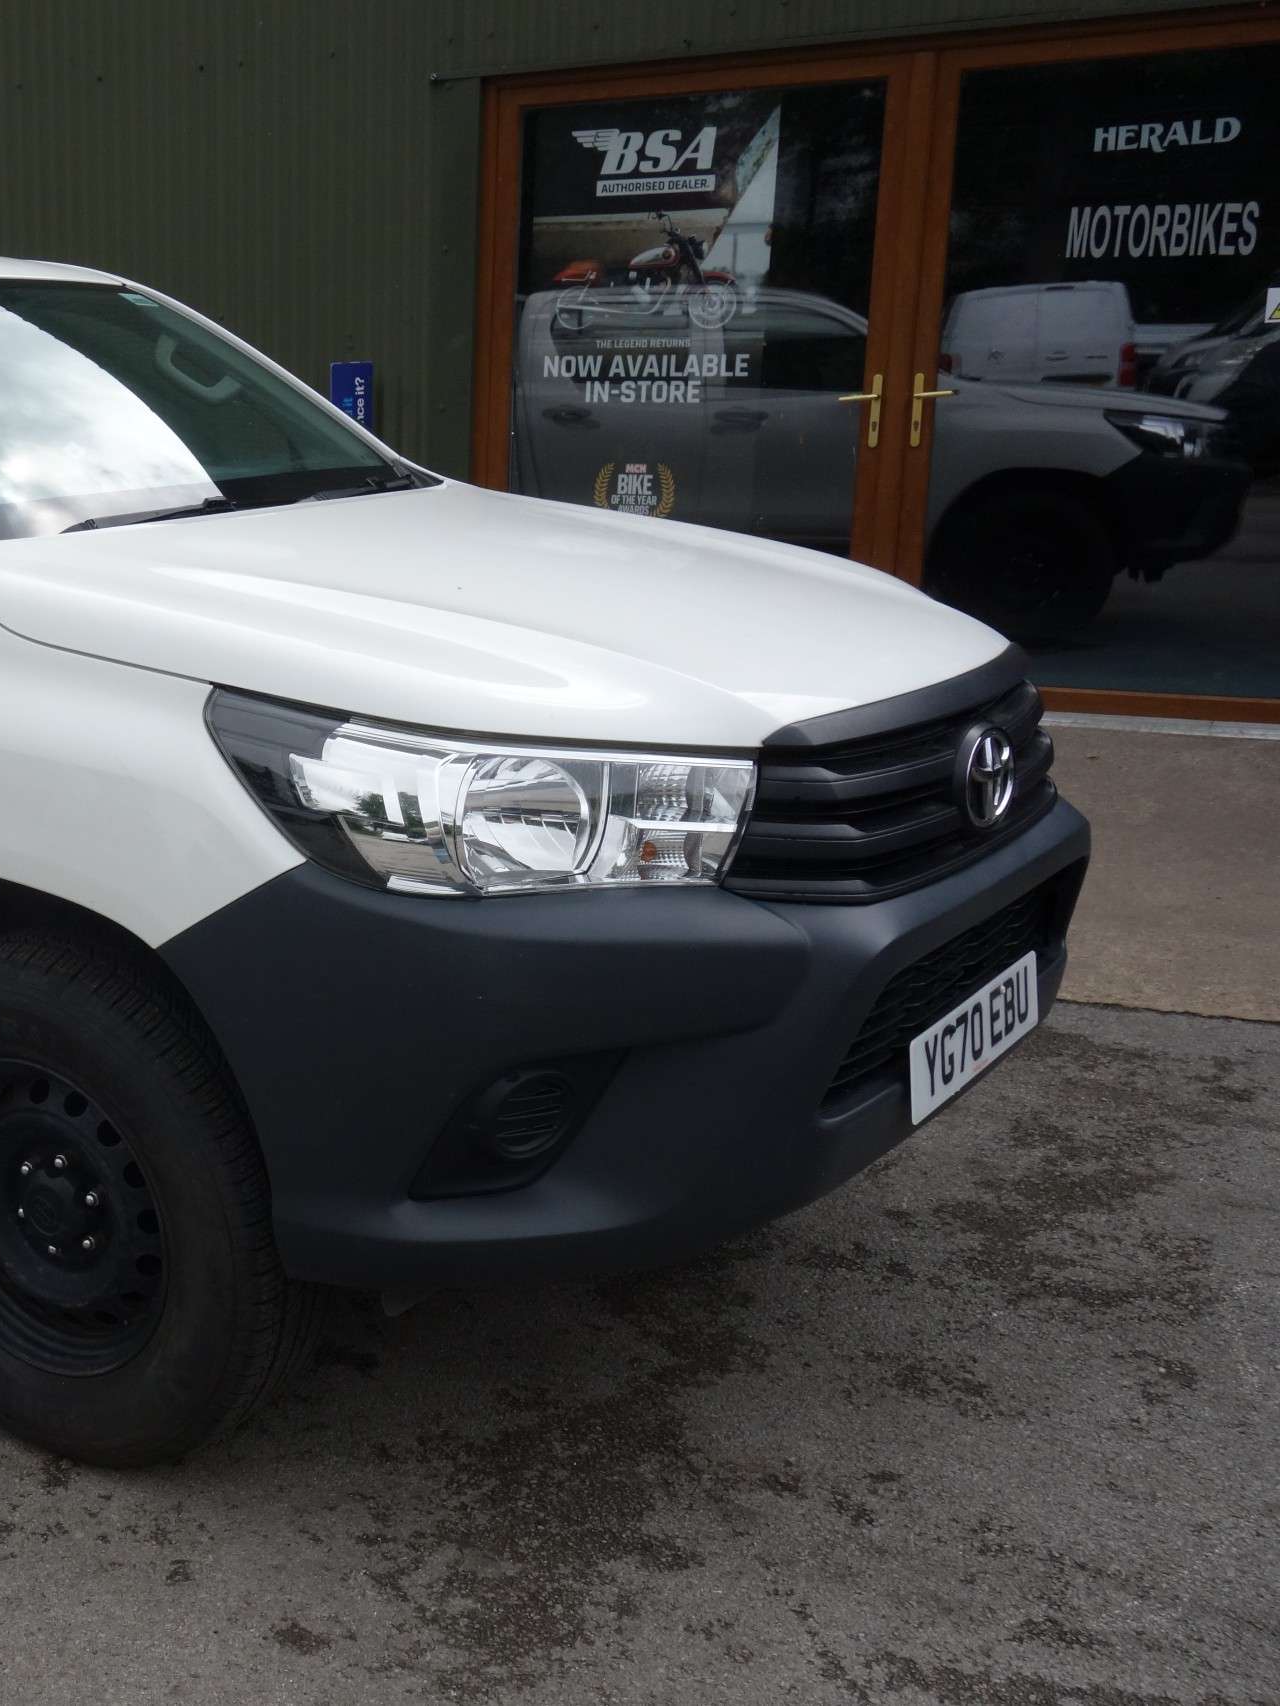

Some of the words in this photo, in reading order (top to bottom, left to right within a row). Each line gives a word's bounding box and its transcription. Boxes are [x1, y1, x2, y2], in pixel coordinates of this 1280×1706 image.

[1093, 116, 1241, 152] HERALD
[598, 126, 718, 175] BSA
[601, 180, 665, 194] AUTHORISED
[1065, 201, 1260, 259] MOTORBIKES
[596, 339, 613, 349] THE
[614, 339, 648, 349] LEGEND
[650, 337, 691, 349] RETURNS
[543, 354, 603, 378] NOW
[608, 353, 750, 378] AVAILABLE
[585, 380, 701, 404] IN-STORE
[625, 463, 648, 474] MCN
[616, 474, 653, 495] BIKE
[610, 495, 621, 505] OF
[622, 495, 636, 505] THE
[637, 495, 658, 506] YEAR
[924, 1001, 985, 1097] YG70
[989, 966, 1030, 1048] EBU
